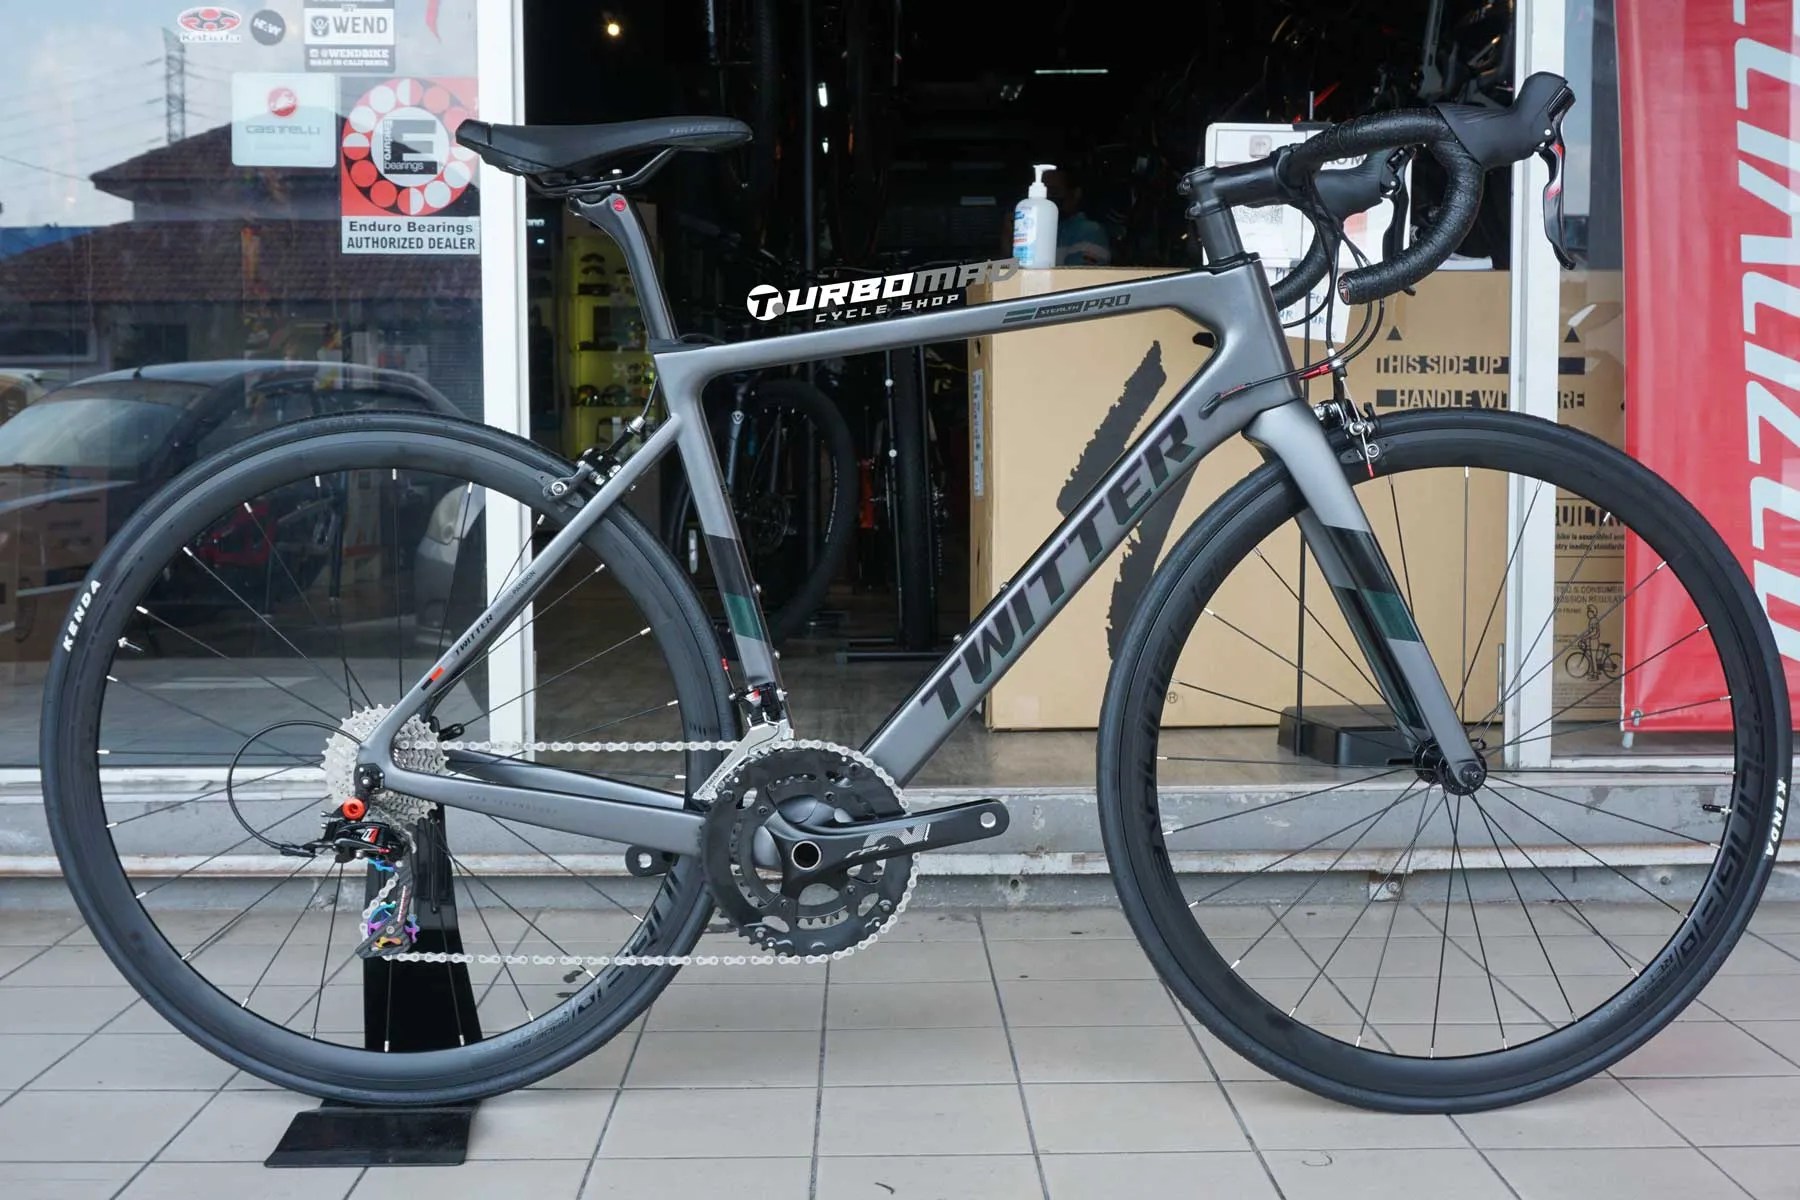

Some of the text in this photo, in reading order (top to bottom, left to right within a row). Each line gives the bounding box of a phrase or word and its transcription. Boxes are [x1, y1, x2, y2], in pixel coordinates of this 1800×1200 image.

[333, 16, 388, 34] WEND
[384, 161, 424, 173] bearings
[349, 221, 473, 235] Enduro Bearings
[346, 236, 476, 250] AUTHORIZED DEALER
[1083, 293, 1132, 313] PRO
[1377, 356, 1503, 374] THIS SIDE UP
[1397, 389, 1472, 409] HANDLE
[919, 413, 1196, 721] TWITTER
[63, 580, 101, 652] KENDA
[453, 613, 494, 656] TWITTER
[1763, 778, 1787, 860] KENDA
